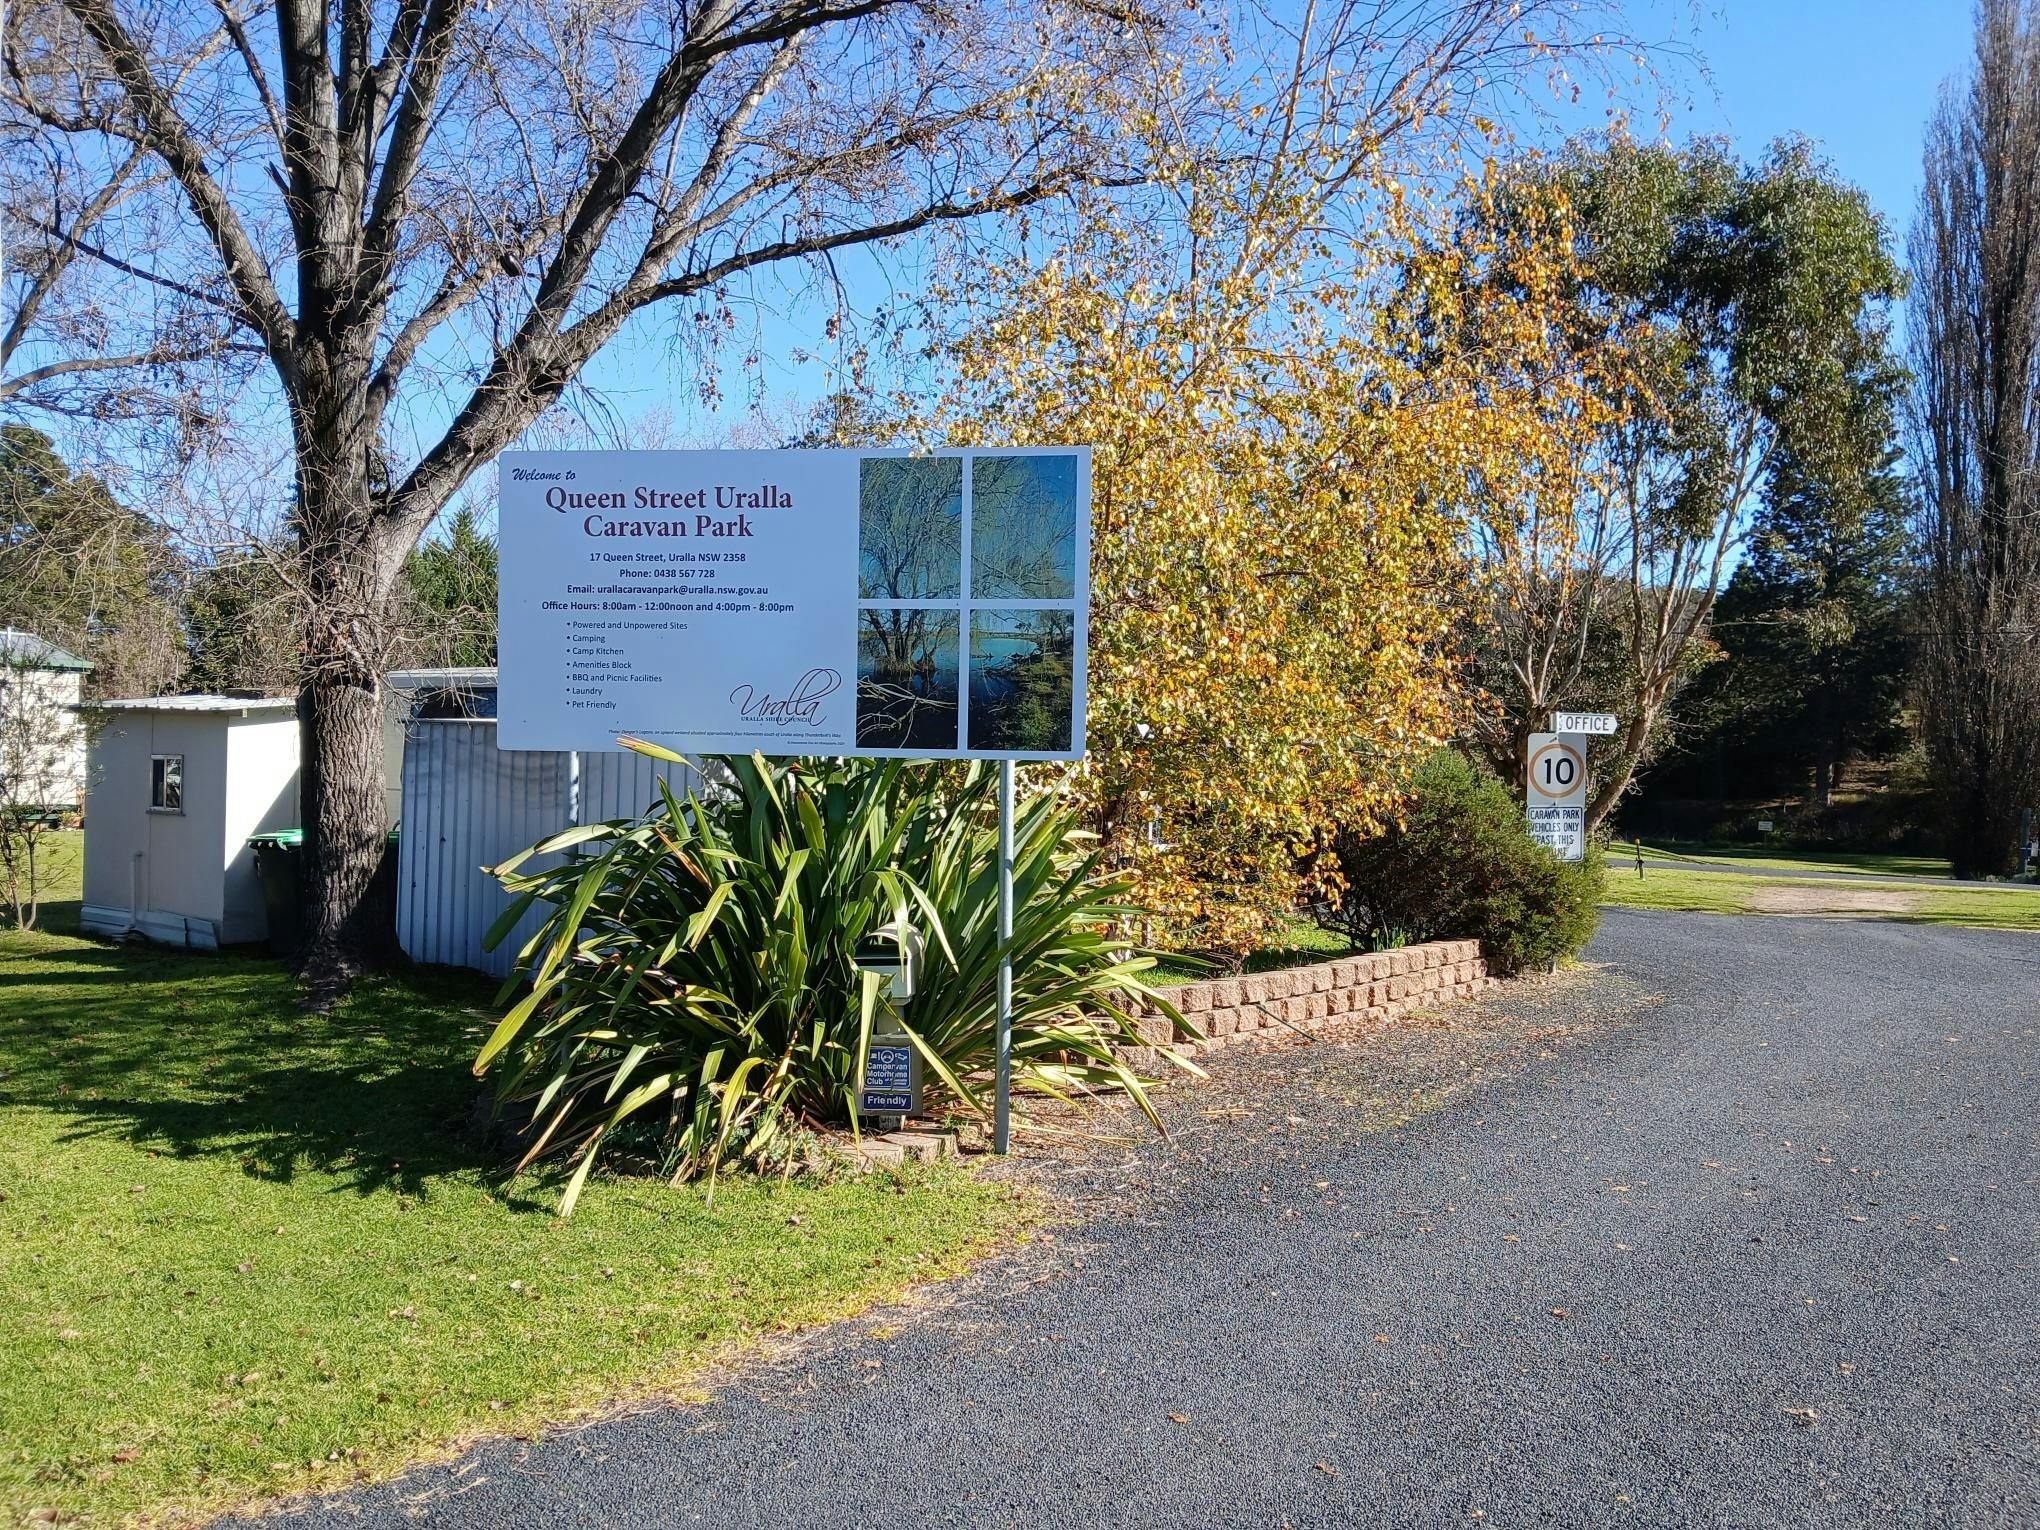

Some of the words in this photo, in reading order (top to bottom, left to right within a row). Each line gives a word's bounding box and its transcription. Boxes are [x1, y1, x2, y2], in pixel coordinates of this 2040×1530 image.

[512, 467, 561, 482] Welcome
[565, 469, 577, 481] to
[545, 486, 626, 513] Queen
[633, 486, 707, 508] Street
[714, 485, 793, 508] Uralla
[583, 514, 687, 537] Caravan
[694, 514, 754, 537] Park
[589, 552, 600, 562] 17
[603, 552, 634, 563] Queen
[635, 552, 666, 564] Street,
[668, 552, 696, 562] Uralla
[698, 552, 721, 562] NSW
[723, 552, 746, 562] 2358
[619, 568, 652, 578] Phone:
[653, 568, 676, 578] 0438
[678, 569, 695, 578] 567
[698, 569, 715, 578] 728
[567, 584, 595, 594] Email:
[597, 584, 768, 597] urallacaravanpark@uralla.nsw.gov.au
[541, 600, 569, 610] Office
[570, 601, 600, 611] Hours:
[602, 601, 637, 611] 8:00am
[645, 601, 694, 611] 12:00noon
[695, 601, 714, 611] and
[715, 602, 751, 614] 4:00pm
[758, 602, 794, 614] 8:00pm
[572, 620, 606, 630] Powered
[607, 621, 622, 630] and
[623, 621, 668, 632] Unpowered
[669, 621, 688, 630] Sites
[572, 634, 606, 644] Camping
[572, 647, 594, 657] Camp
[596, 647, 625, 656] Kitchen
[572, 660, 610, 669] Amenities
[612, 660, 632, 669] Block
[572, 673, 590, 683] BBQ
[591, 673, 605, 682] and
[606, 673, 629, 683] Picnic
[630, 673, 663, 683] Facilities
[572, 686, 603, 696] Laundry
[729, 668, 842, 726] Uralla
[572, 700, 585, 709] Pet
[586, 700, 617, 711] Friendly
[1565, 715, 1610, 731] OFFICE
[1544, 757, 1575, 785] 10
[1530, 809, 1560, 820] CARAVAN
[1562, 809, 1580, 820] PARK
[1530, 822, 1561, 832] VEHICLES
[1563, 822, 1580, 832] ONLY
[1536, 834, 1554, 845] PAST
[1557, 834, 1575, 845] THIS
[867, 1096, 907, 1107] Friendly
